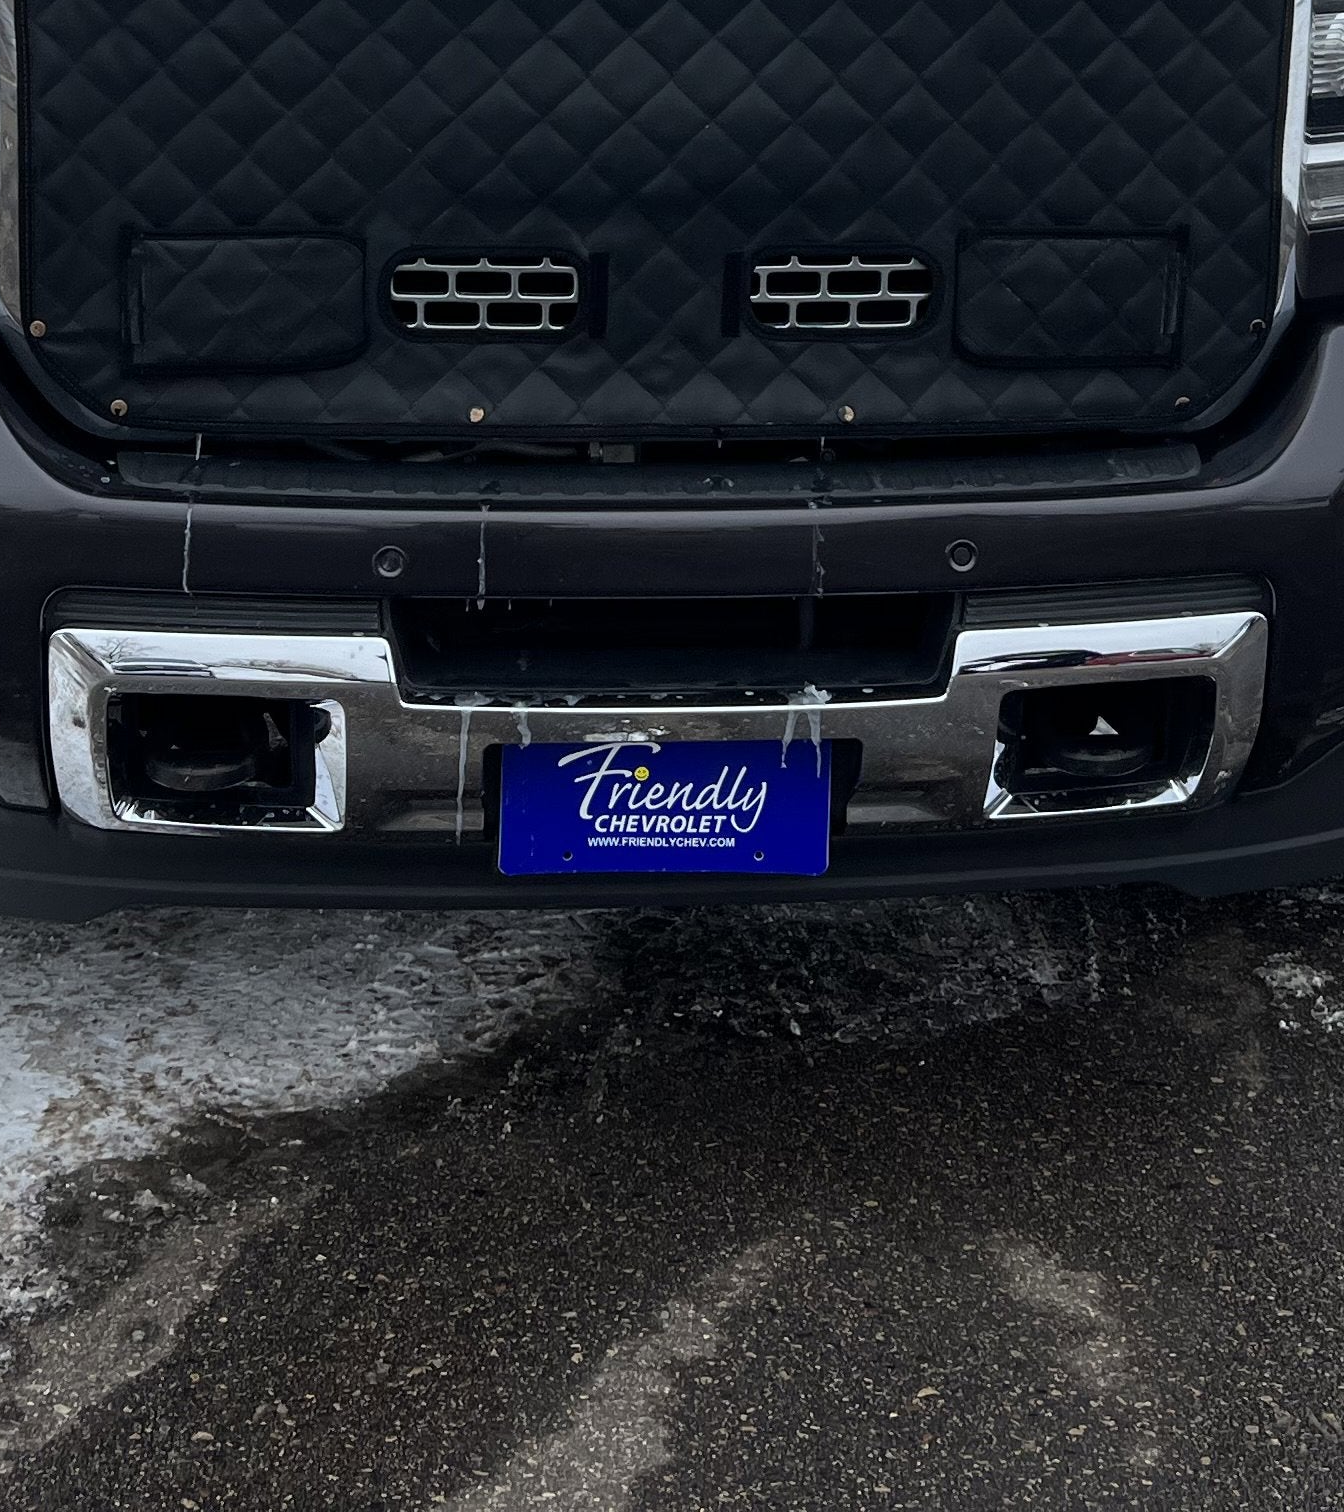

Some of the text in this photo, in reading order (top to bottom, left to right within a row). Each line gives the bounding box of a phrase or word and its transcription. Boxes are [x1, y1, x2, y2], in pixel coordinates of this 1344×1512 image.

[557, 741, 768, 833] Friendly
[594, 814, 728, 833] CHEVROLET
[587, 836, 736, 848] WWW.FRIENDLYCHEV.COM
